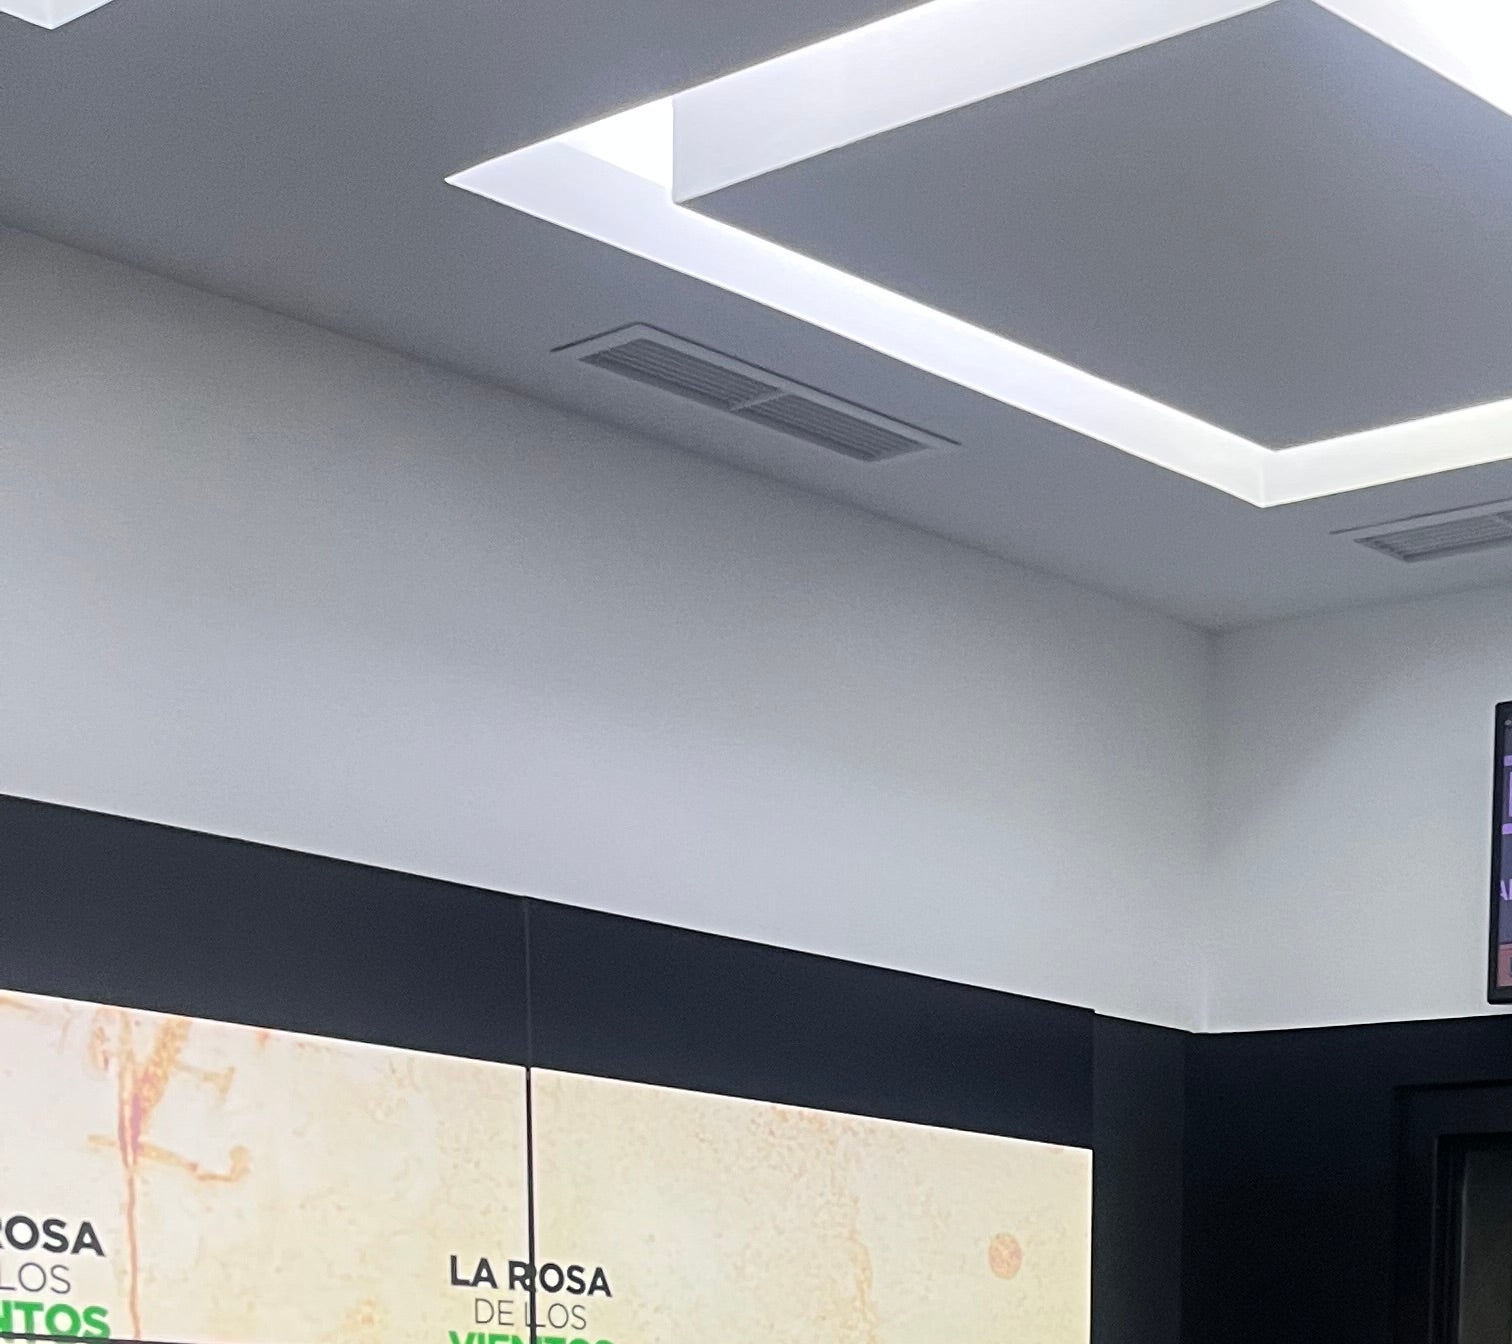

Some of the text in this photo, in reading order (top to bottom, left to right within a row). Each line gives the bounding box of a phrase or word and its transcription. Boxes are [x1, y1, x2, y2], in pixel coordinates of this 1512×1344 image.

[0, 1215, 105, 1257] OSA
[449, 1254, 613, 1298] LA ROSA
[474, 1297, 588, 1331] DE LOS
